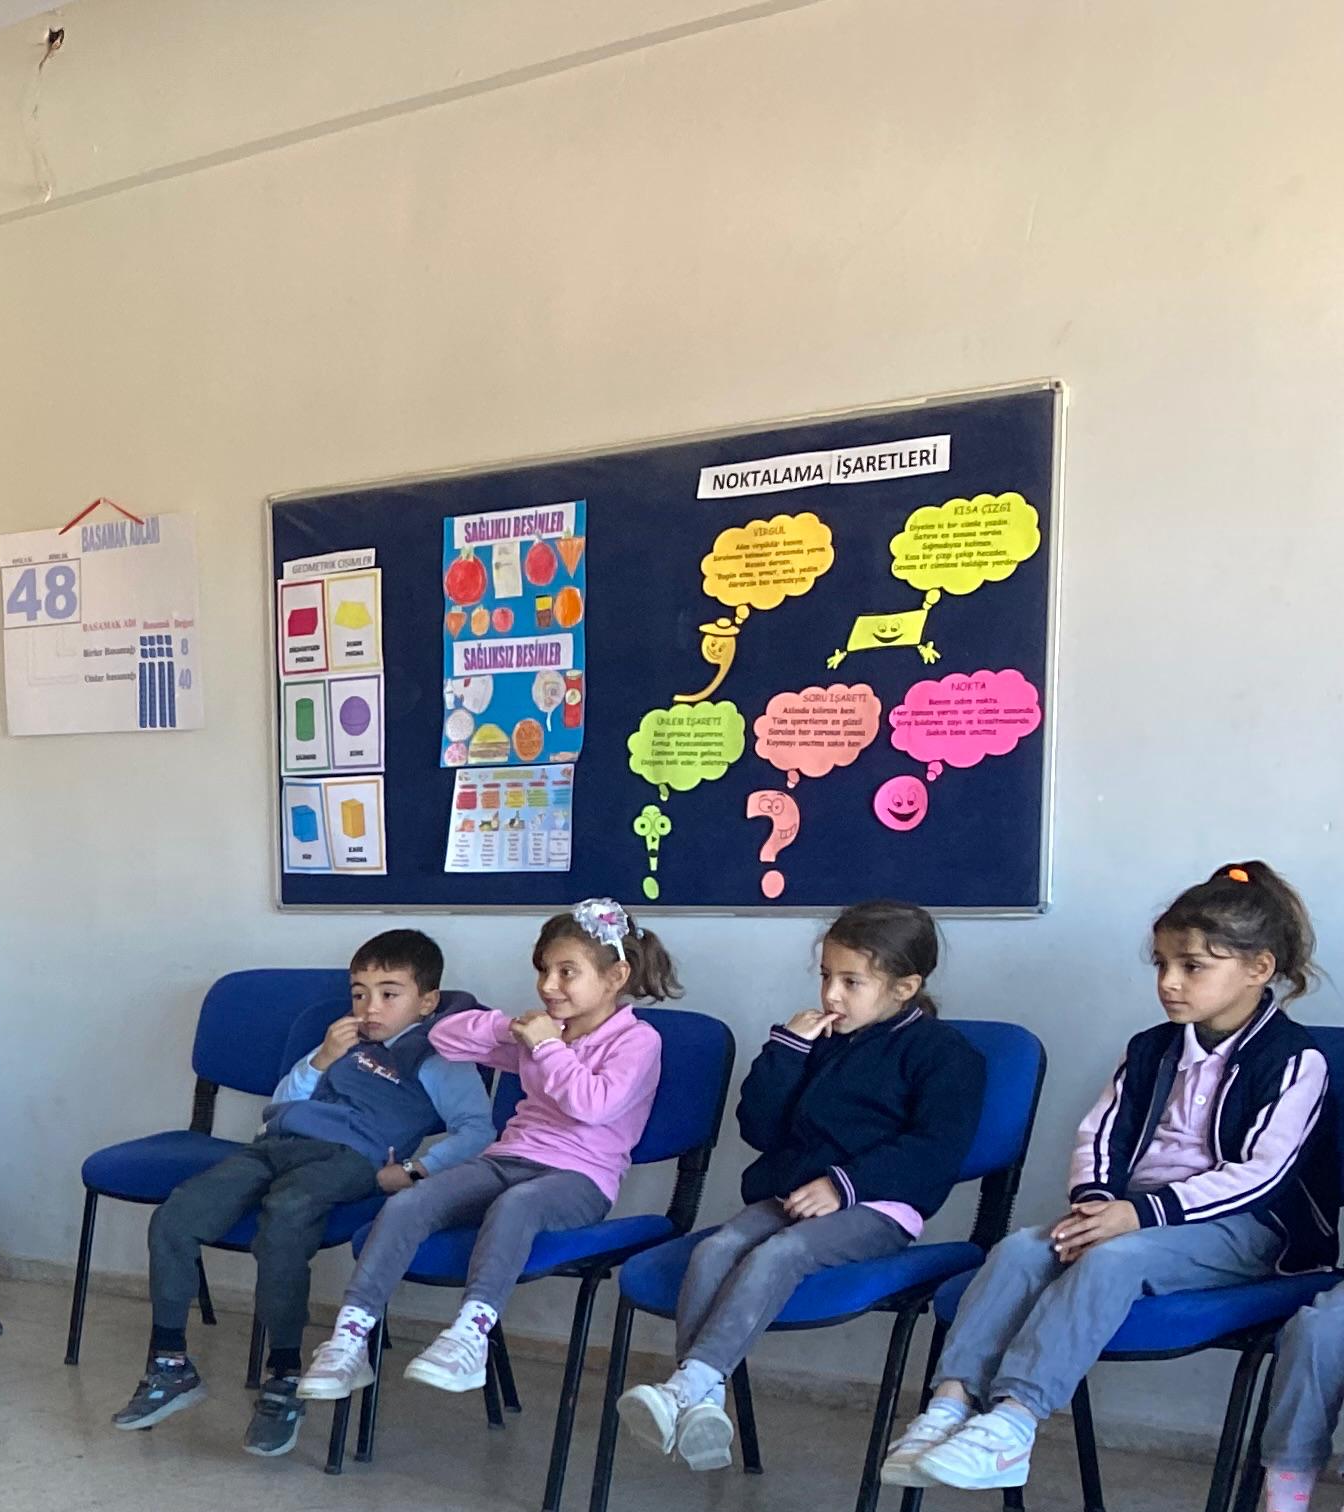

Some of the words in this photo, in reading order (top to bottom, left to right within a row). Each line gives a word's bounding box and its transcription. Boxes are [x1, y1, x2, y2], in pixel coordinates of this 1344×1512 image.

[712, 463, 824, 491] NOKTALAMA
[836, 444, 938, 479] İŞARETLERİ
[464, 517, 511, 543] SAĞLIKLI
[513, 510, 564, 537] BESİNLER
[6, 565, 77, 621] 48
[181, 638, 189, 655] 8
[463, 643, 513, 671] SAĞLIKSIZ
[516, 640, 561, 668] BESİNLER
[951, 682, 986, 691] NOKTA
